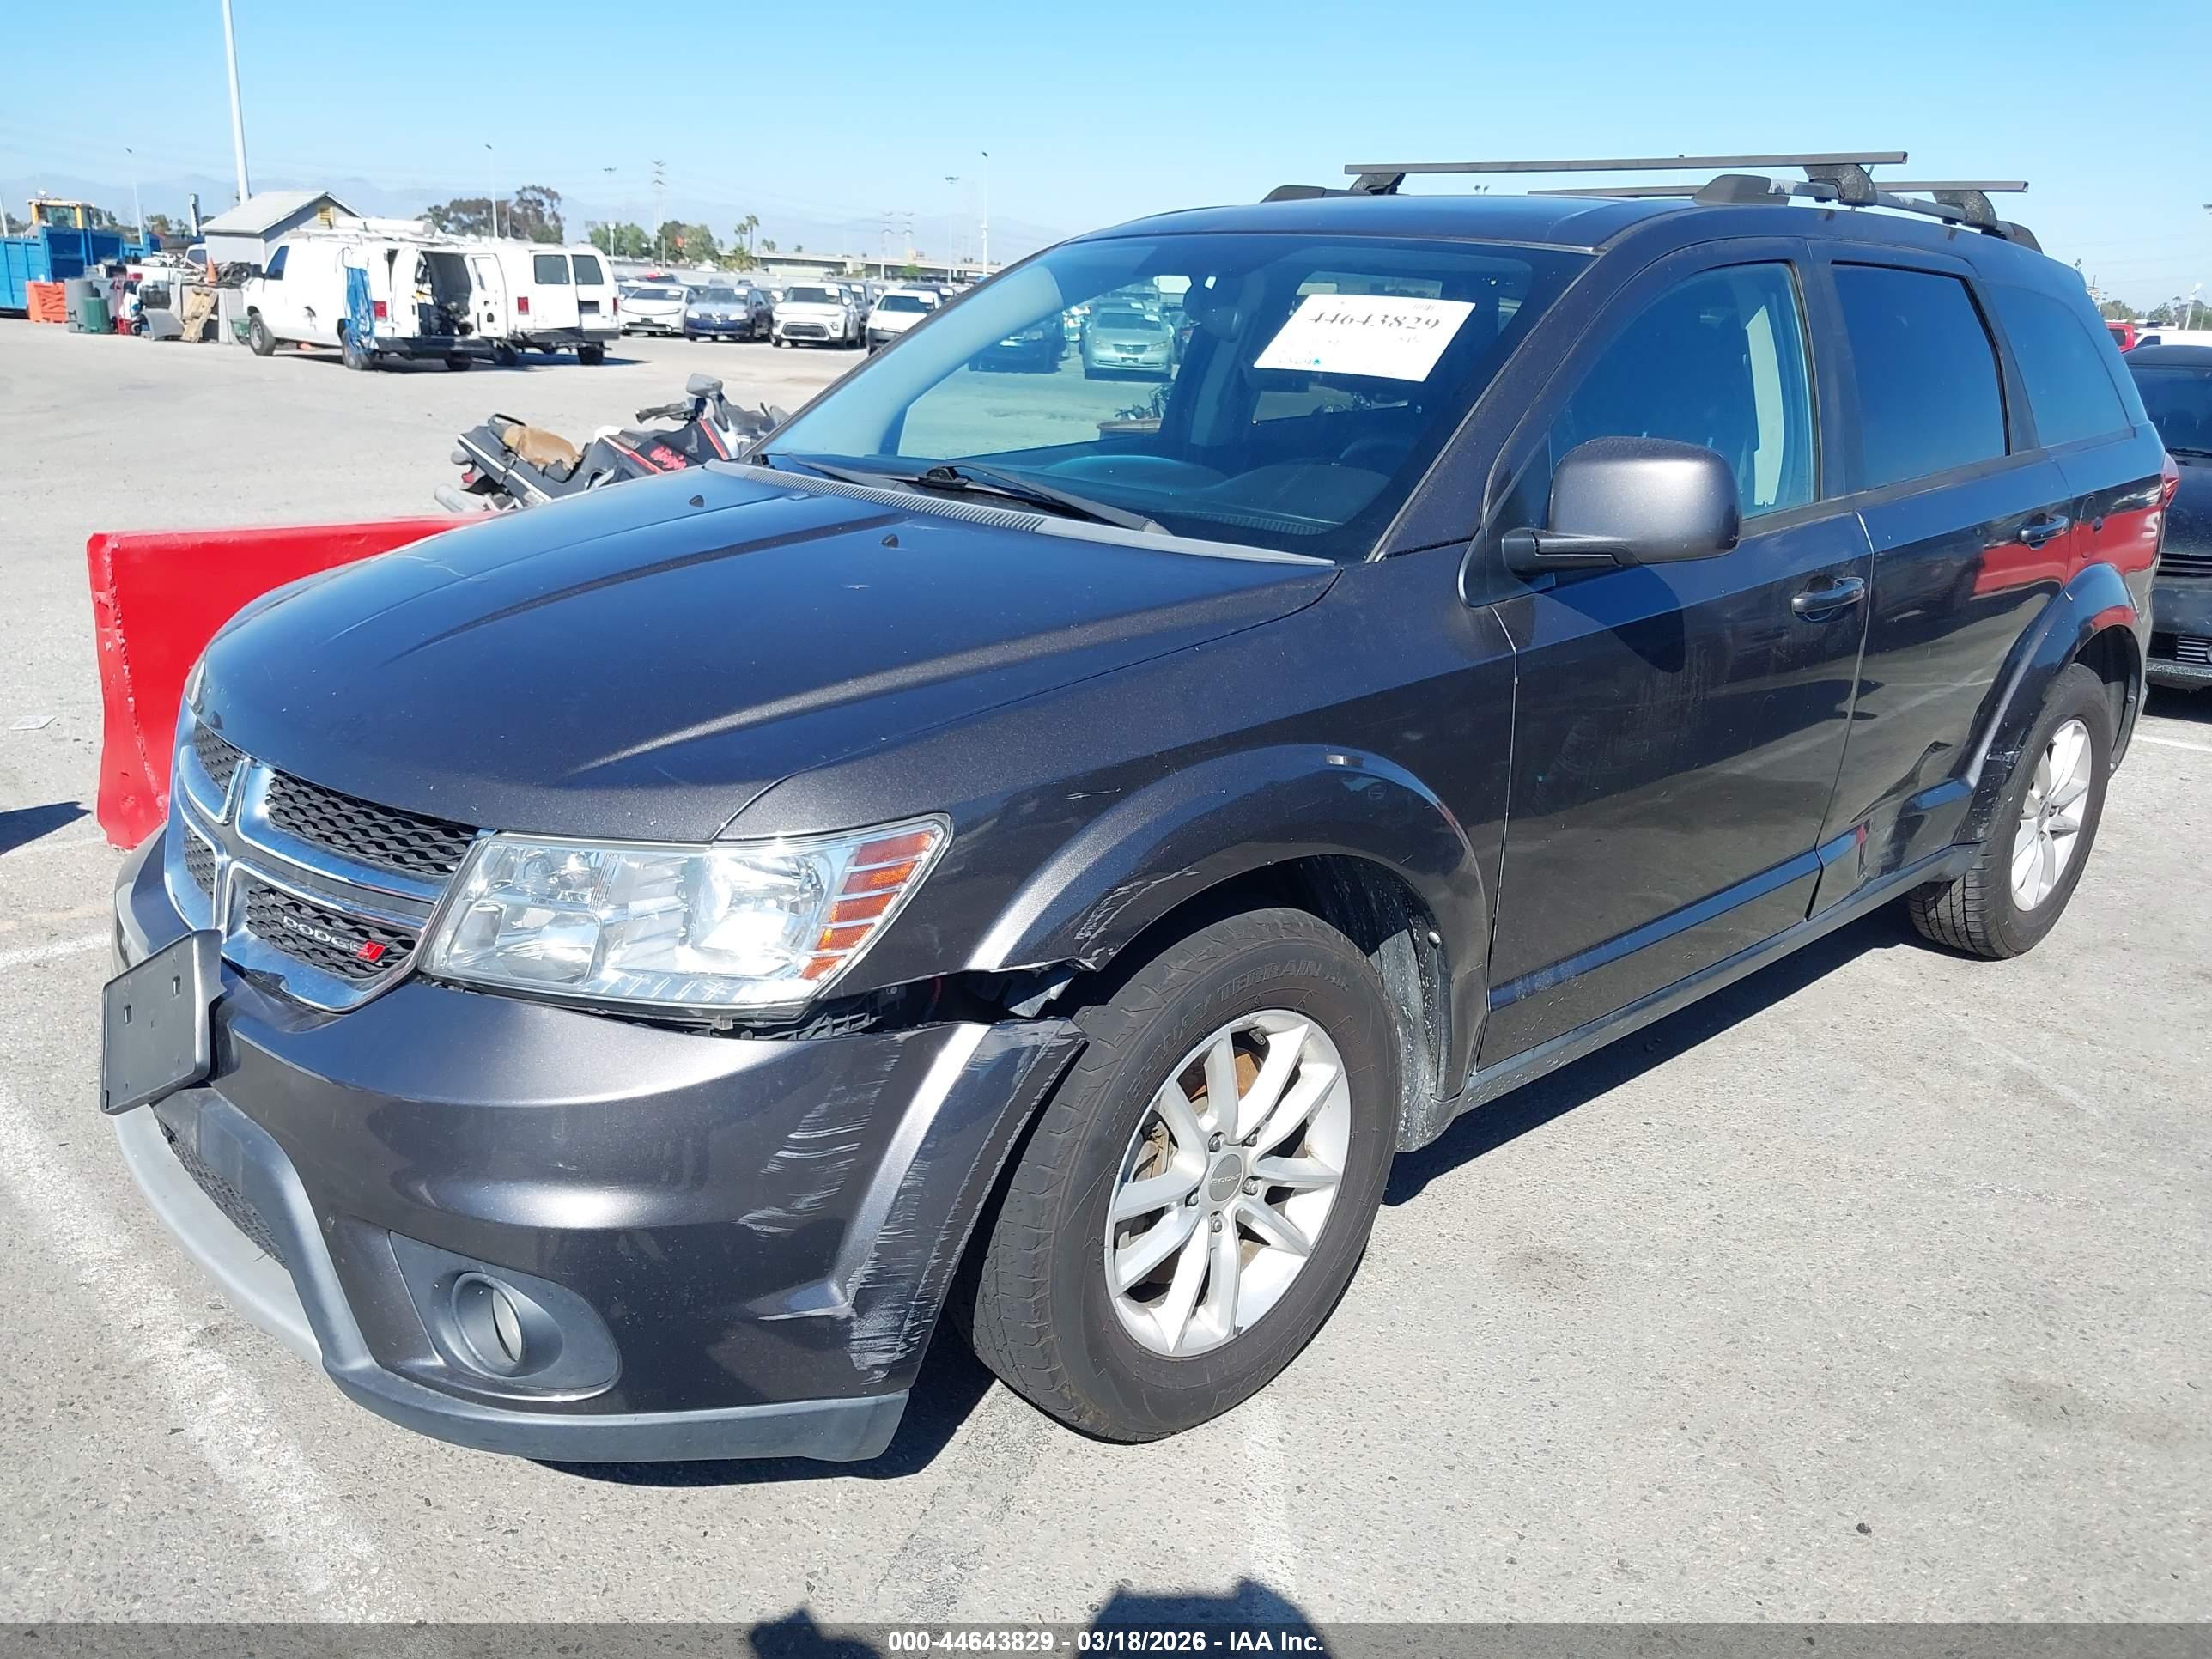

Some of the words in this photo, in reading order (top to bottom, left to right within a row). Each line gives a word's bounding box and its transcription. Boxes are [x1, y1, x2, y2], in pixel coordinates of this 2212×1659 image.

[1308, 311, 1441, 330] 44643829
[283, 915, 361, 953] DODGE
[1216, 959, 1322, 1002] TERRAIN
